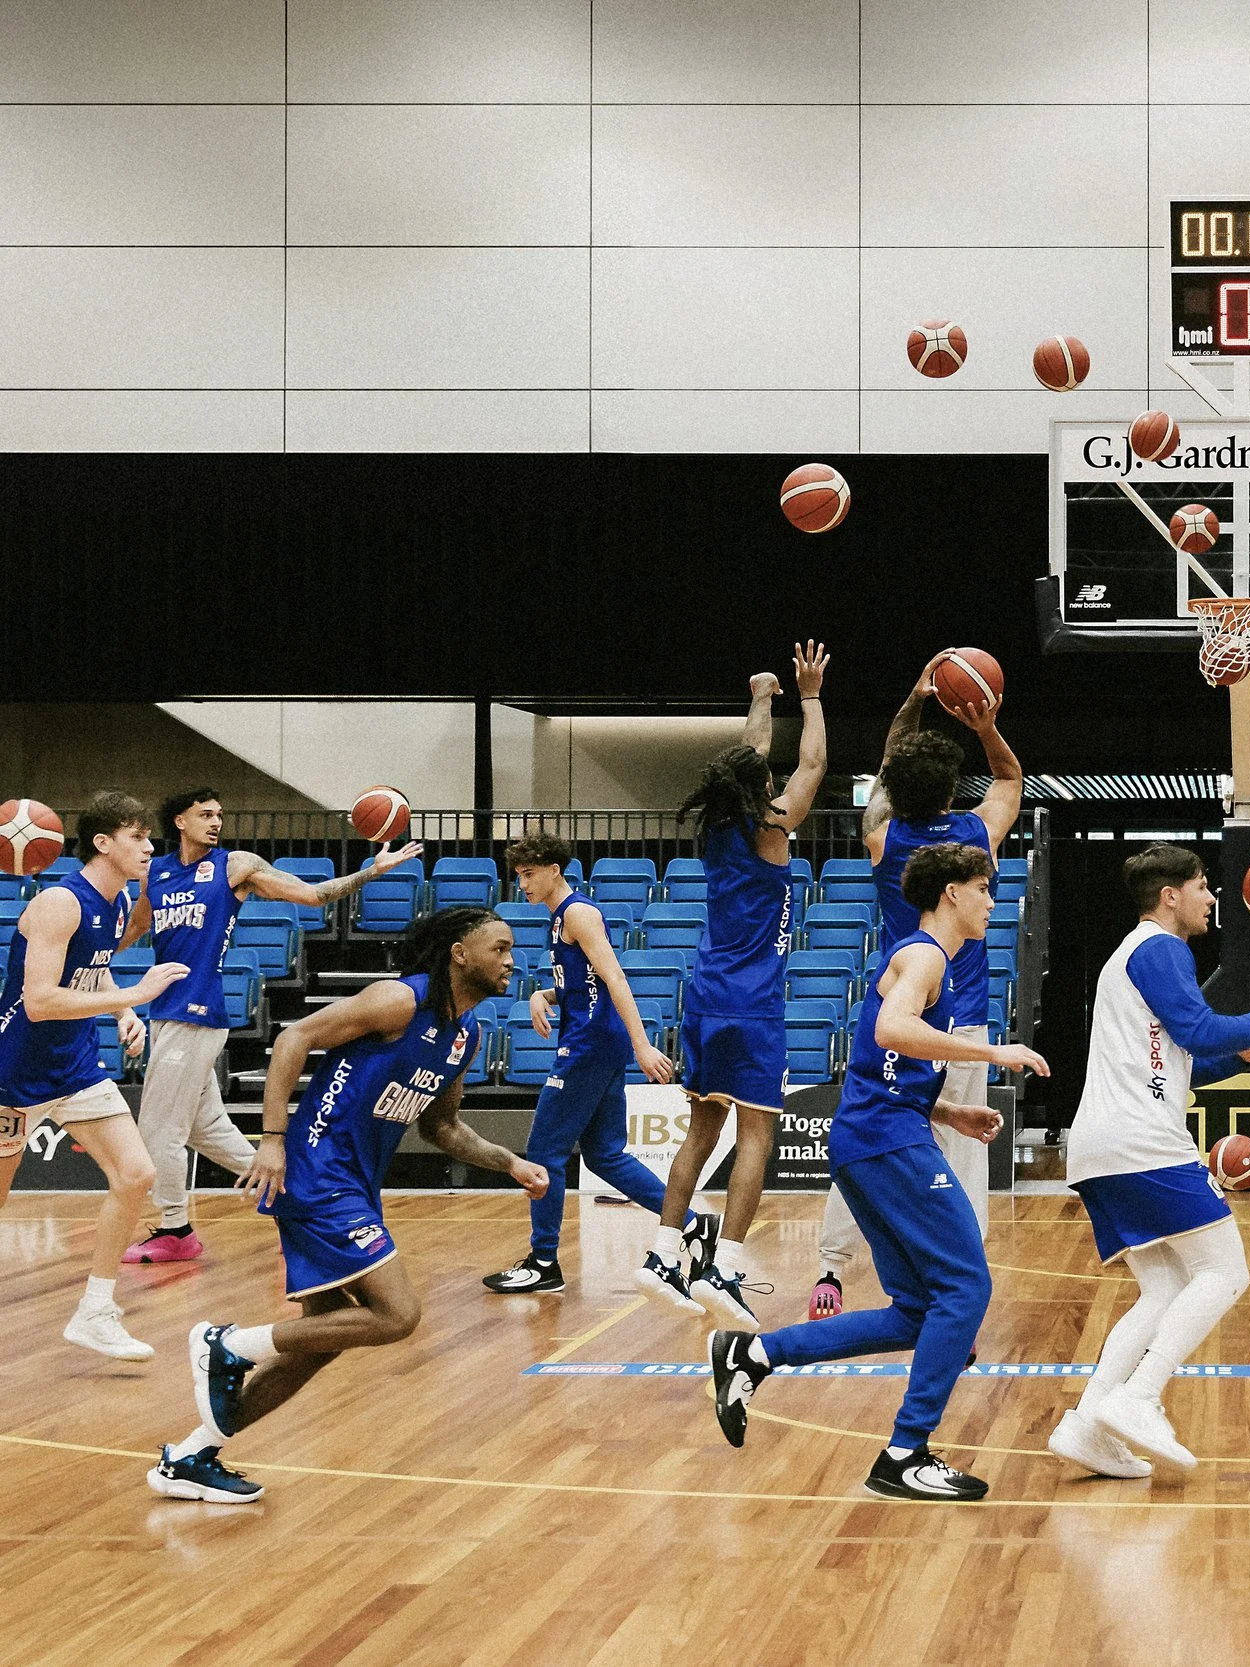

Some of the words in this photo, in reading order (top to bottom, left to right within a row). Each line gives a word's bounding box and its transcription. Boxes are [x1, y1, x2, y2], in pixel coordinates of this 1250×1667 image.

[1179, 326, 1213, 347] hmi
[1083, 436, 1143, 477] G.J.
[1084, 601, 1111, 609] balance
[162, 890, 196, 907] NBS
[153, 903, 207, 934] GIANTS
[90, 949, 113, 966] NBS
[1149, 1022, 1163, 1070] SPORT
[883, 1050, 899, 1080] SPO
[321, 1058, 353, 1115] SPORT
[408, 1067, 445, 1092] NBS
[372, 1081, 436, 1125] GIANT
[641, 1365, 884, 1374] CHMIST
